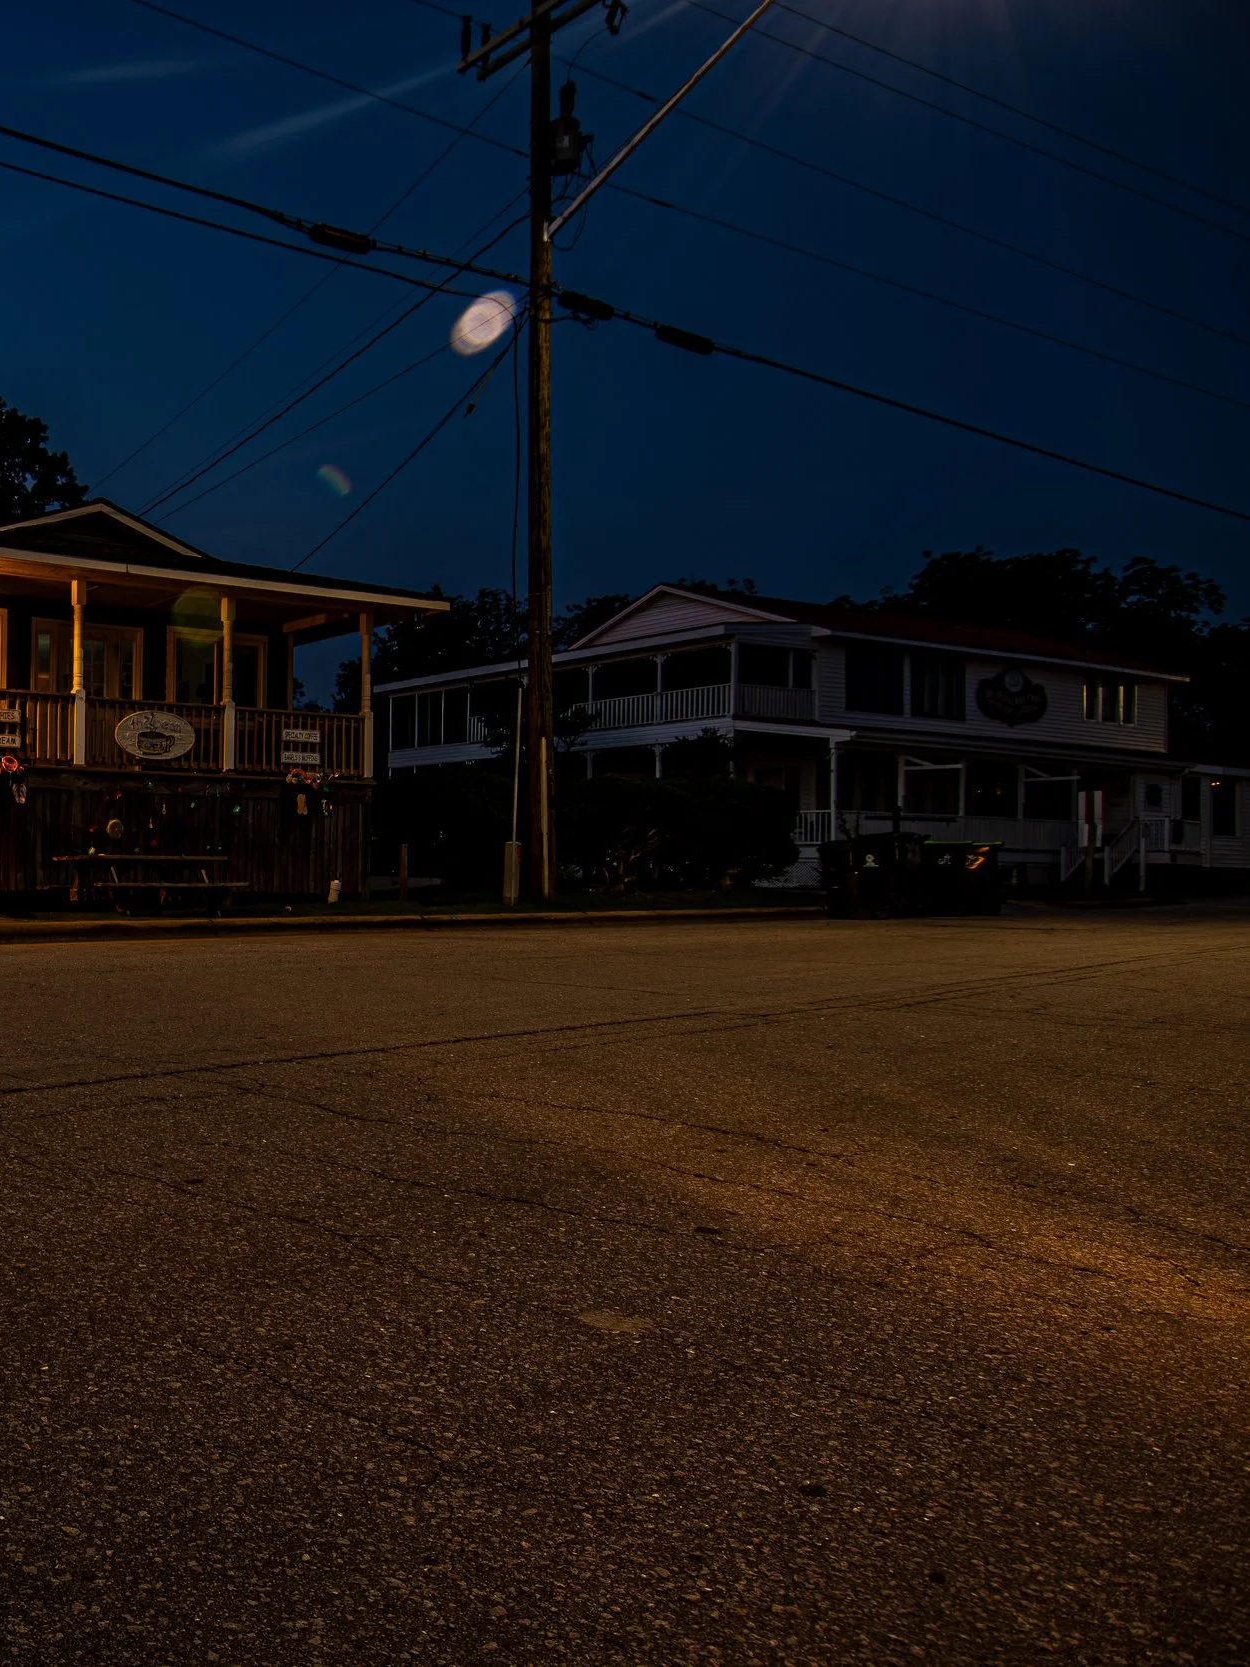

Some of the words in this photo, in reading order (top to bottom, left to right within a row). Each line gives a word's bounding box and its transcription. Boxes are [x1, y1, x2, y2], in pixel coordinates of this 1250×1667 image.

[284, 731, 304, 739] SPECIALTY
[305, 732, 319, 740] COFFEE
[284, 753, 298, 761] BAGELS
[301, 754, 319, 762] MUFFINS
